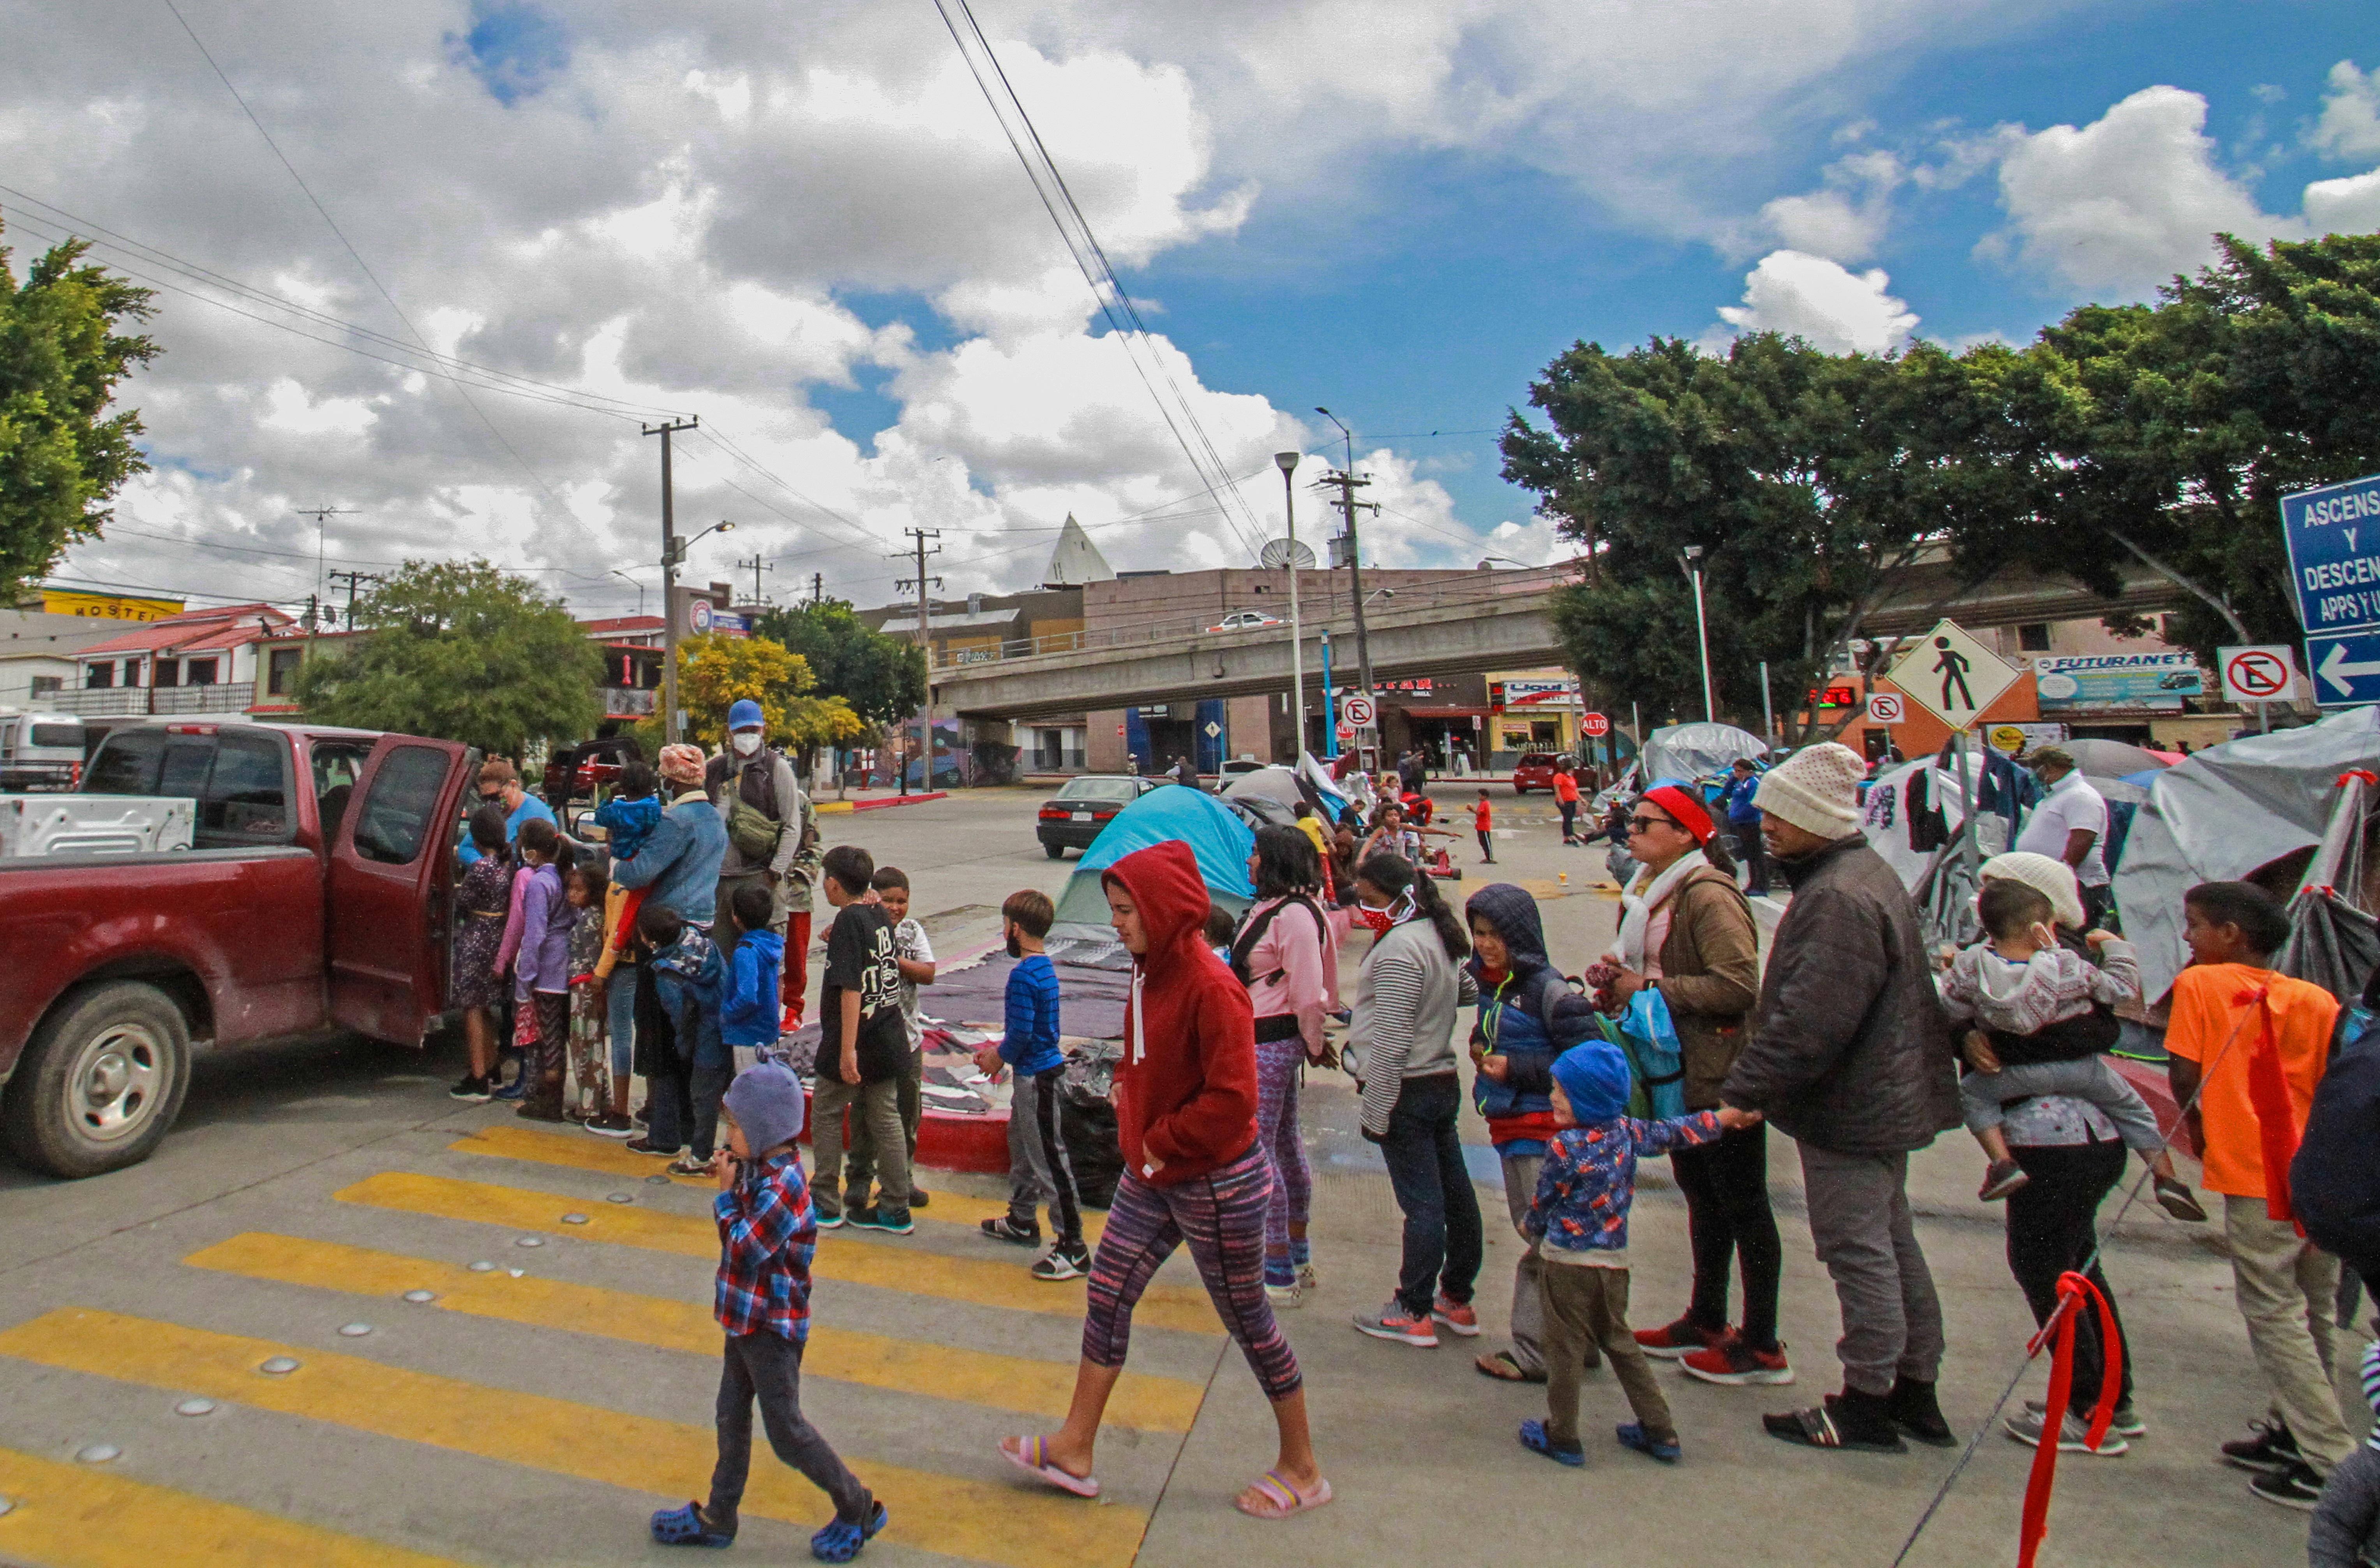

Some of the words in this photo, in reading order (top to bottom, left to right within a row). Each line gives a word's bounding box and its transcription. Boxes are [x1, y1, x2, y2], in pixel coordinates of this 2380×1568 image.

[2304, 490, 2380, 529] ASCENS
[2343, 527, 2357, 552] Y
[2304, 555, 2380, 591] DESCEN
[2320, 594, 2358, 622] APPS
[2357, 592, 2369, 616] Y
[2055, 654, 2192, 668] FUTURANET
[1583, 721, 1606, 729] ALTO
